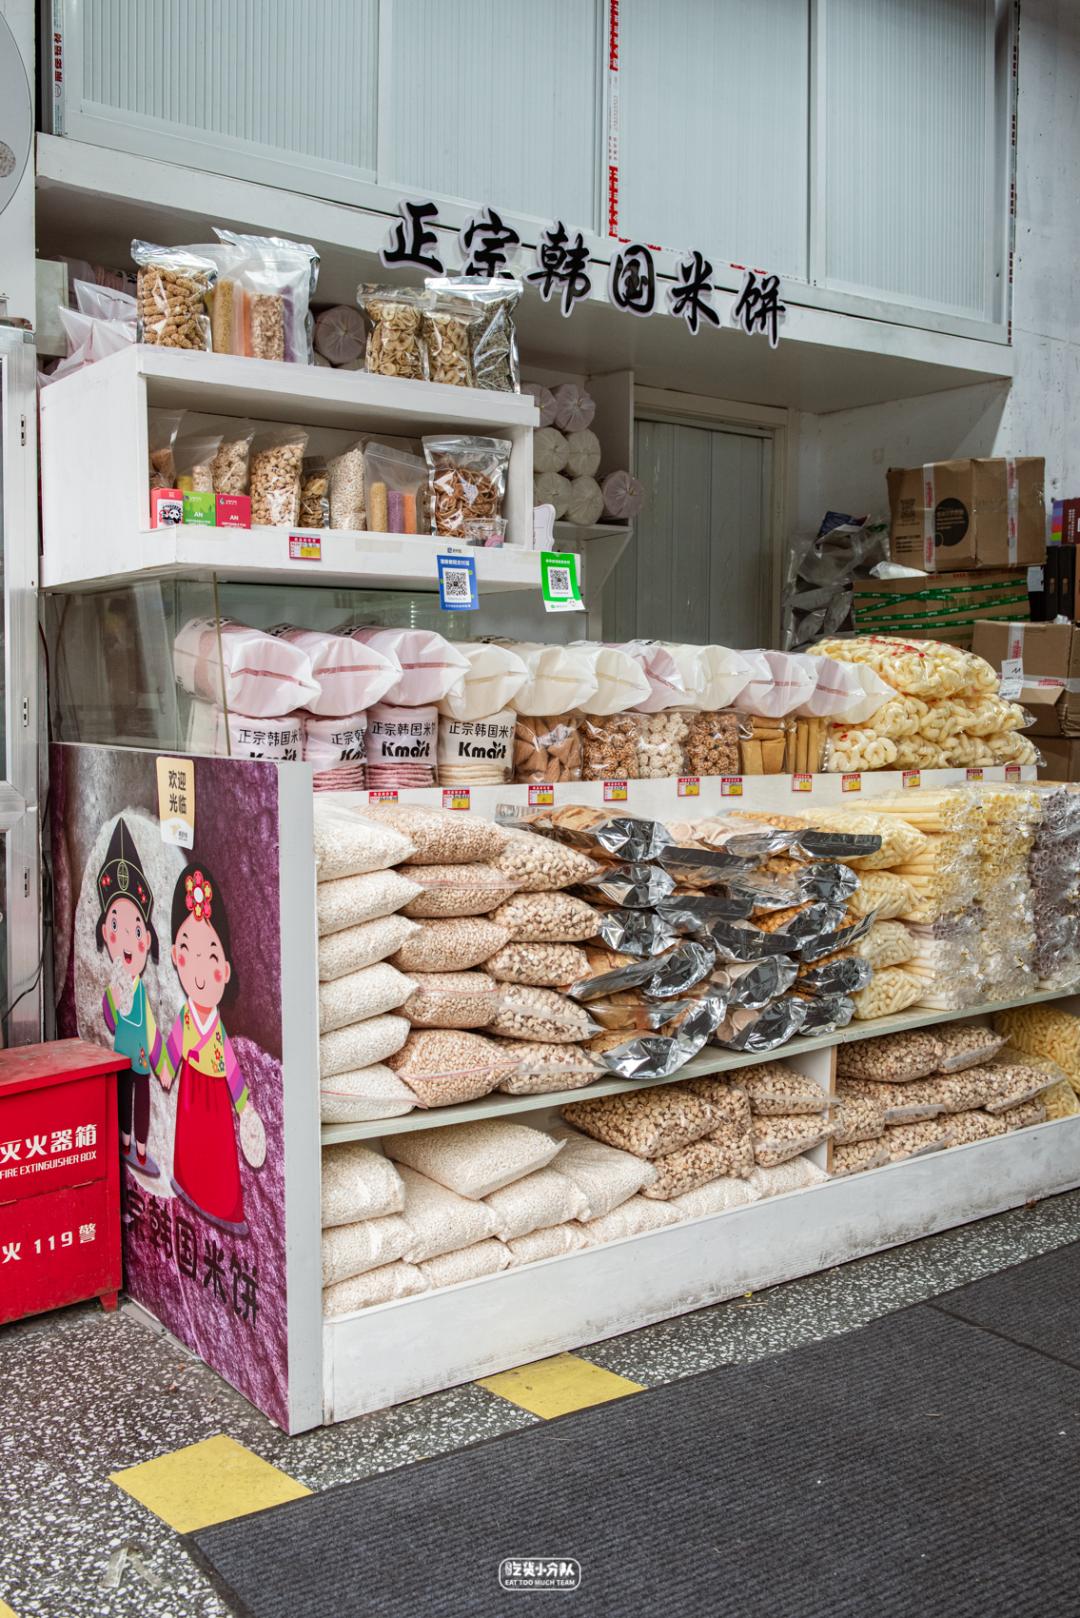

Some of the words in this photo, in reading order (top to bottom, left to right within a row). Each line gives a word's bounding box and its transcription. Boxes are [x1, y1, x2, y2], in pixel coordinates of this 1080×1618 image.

[381, 200, 787, 347] 正宗韩国米饼
[238, 728, 302, 747] 正宗韩国米
[449, 721, 514, 739] 正宗韩国米
[381, 739, 431, 758] Kmart
[458, 740, 507, 759] Kmart
[168, 769, 187, 791] 欢迎
[169, 793, 187, 815] 光临
[0, 1123, 97, 1164] 灭火器箱
[0, 1167, 18, 1179] FIRE
[20, 1154, 79, 1175] EXTINGUISHER
[80, 1150, 96, 1162] BOX
